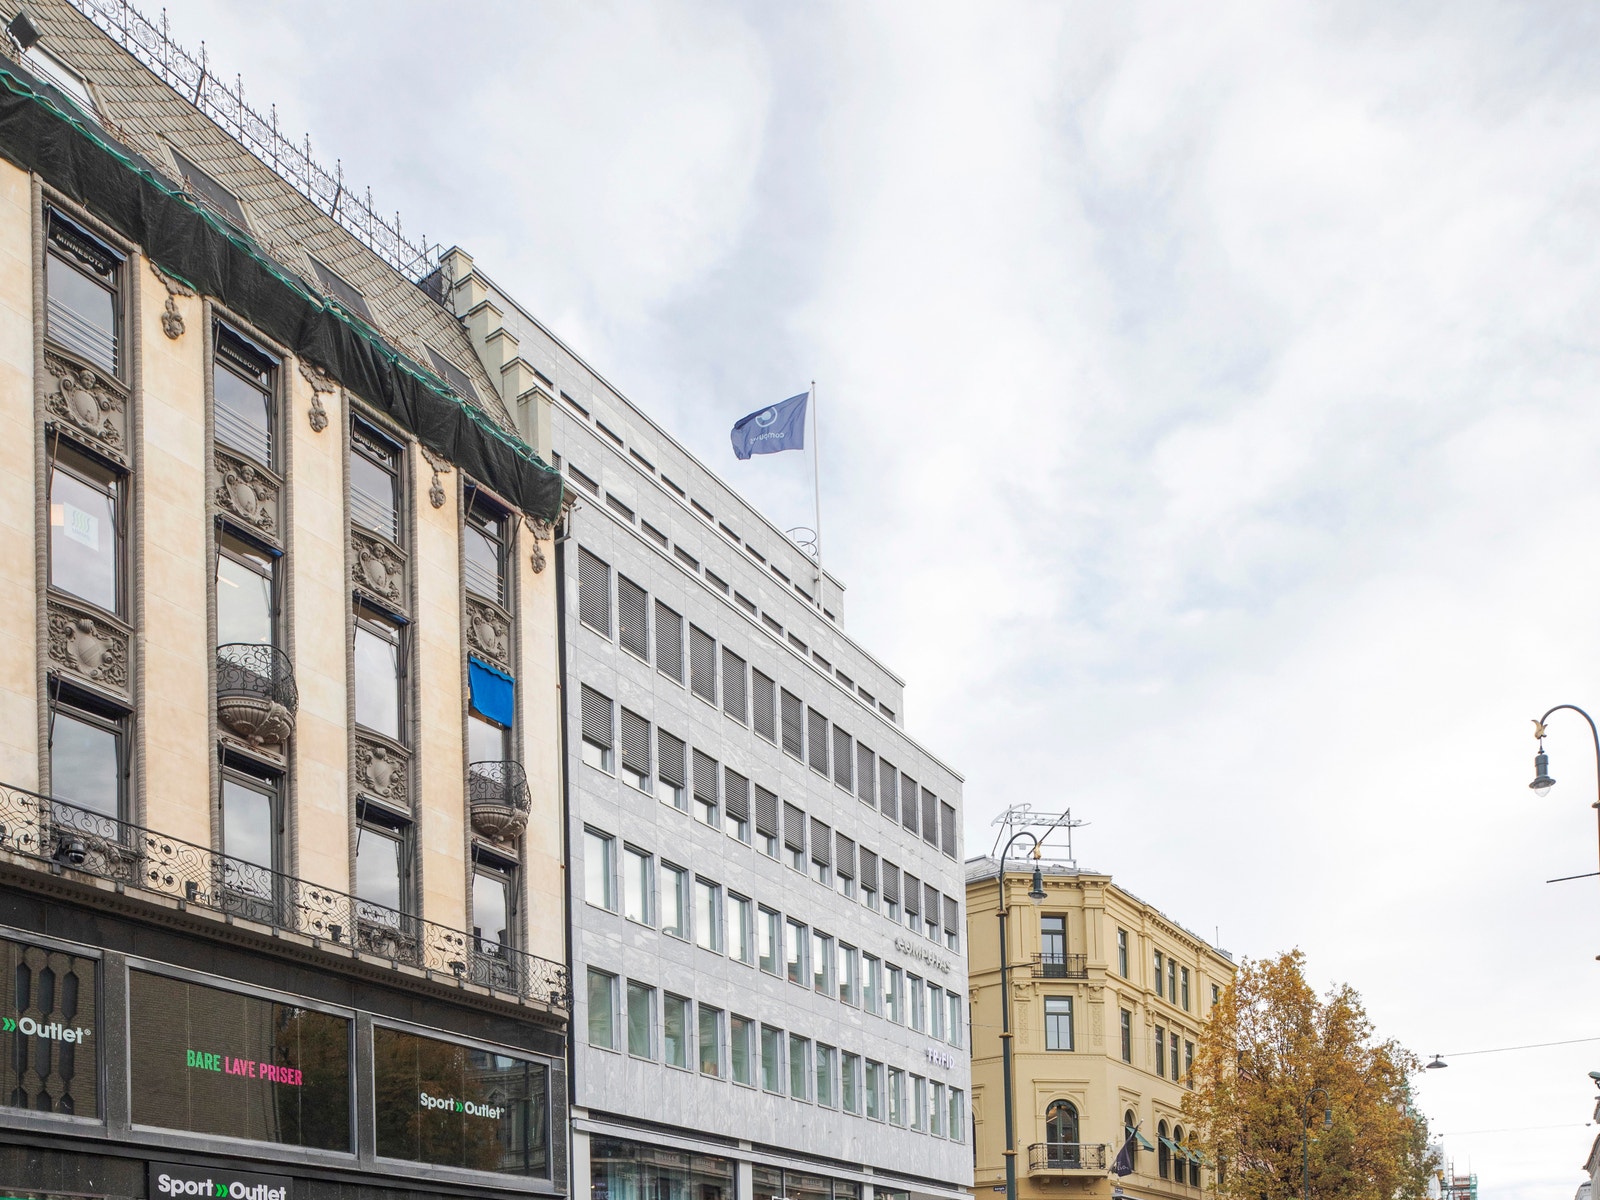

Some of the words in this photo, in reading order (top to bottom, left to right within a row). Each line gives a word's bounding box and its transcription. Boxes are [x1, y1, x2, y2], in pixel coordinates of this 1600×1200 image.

[56, 234, 104, 269] MINNESOTA
[187, 1049, 221, 1072] BARE
[224, 1056, 256, 1078] LAVE
[259, 1062, 302, 1086] PRISER
[420, 1092, 454, 1110] Sport
[158, 1173, 214, 1198] Sport
